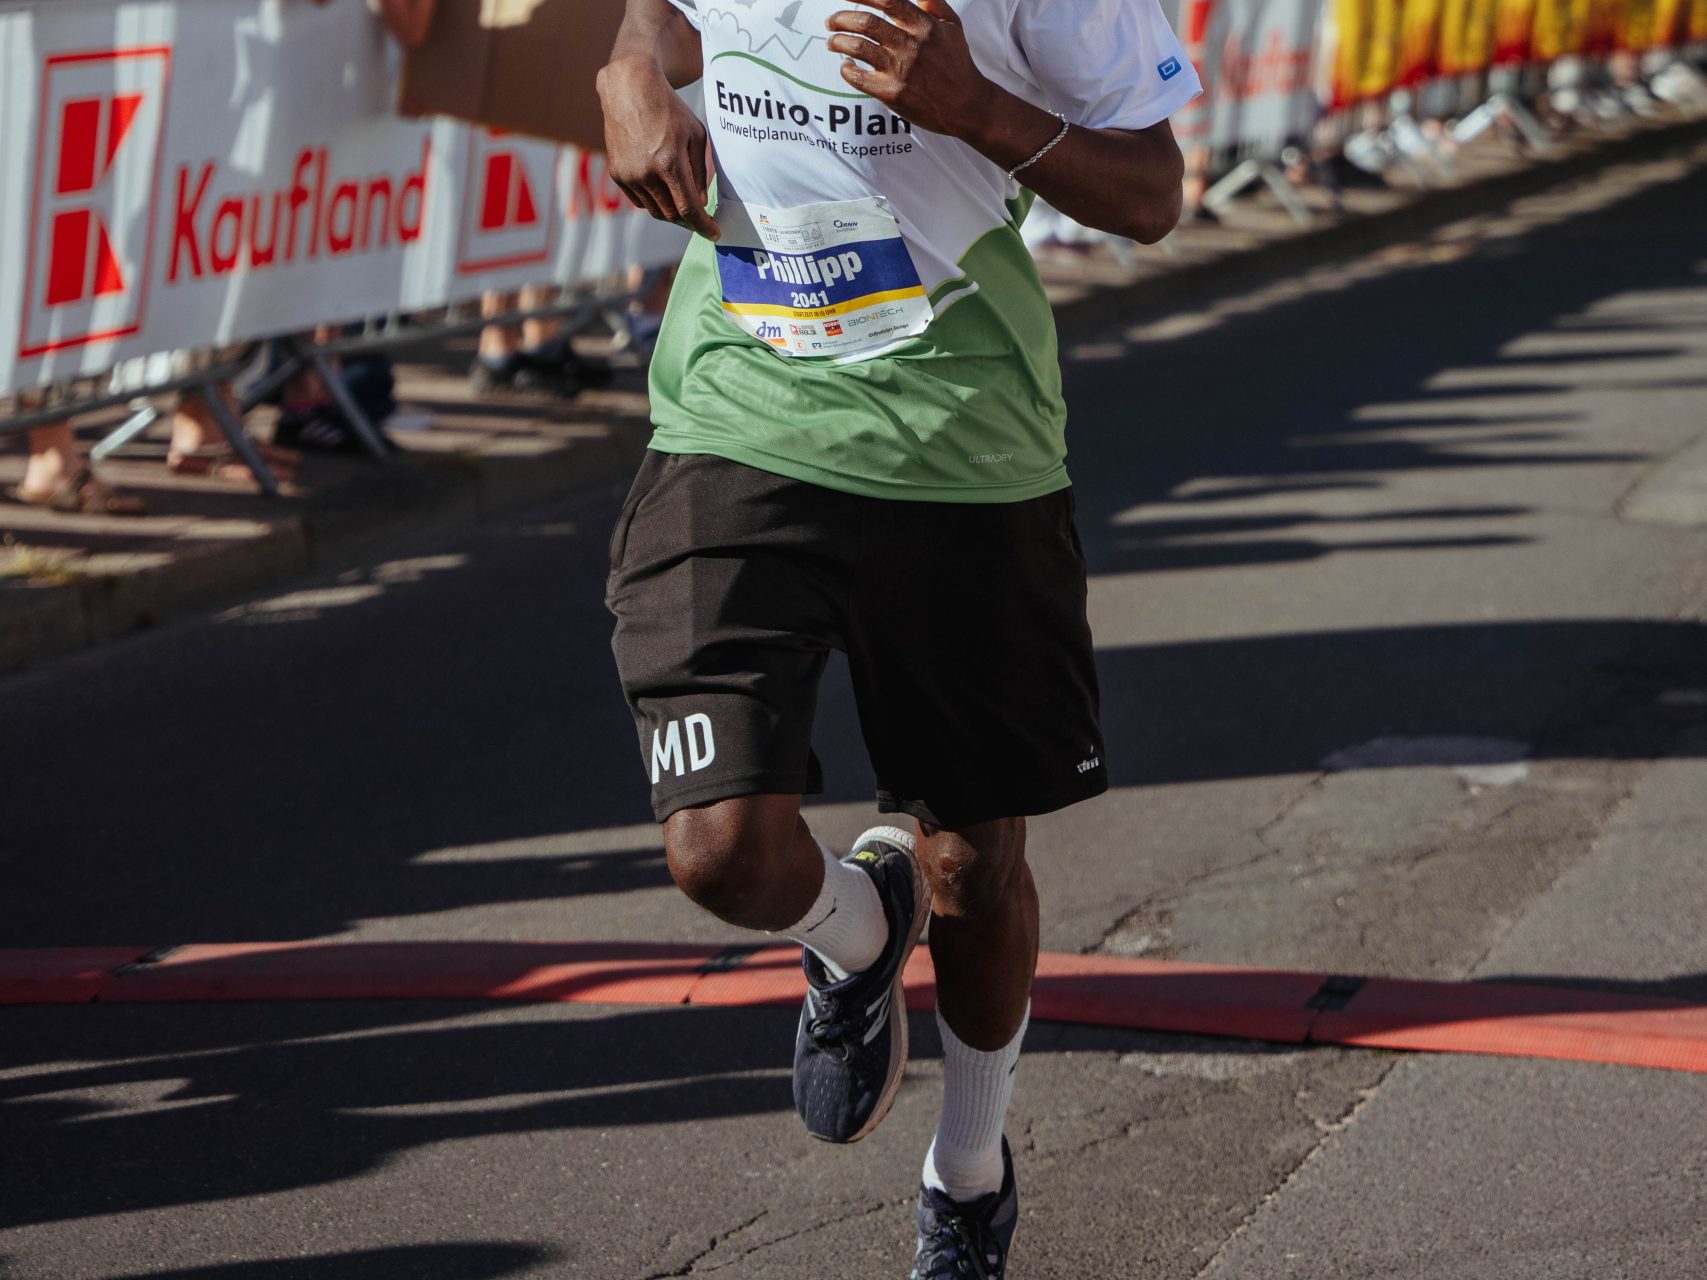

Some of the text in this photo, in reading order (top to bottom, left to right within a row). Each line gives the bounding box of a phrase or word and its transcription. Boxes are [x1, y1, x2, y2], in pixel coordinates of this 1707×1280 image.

[716, 80, 911, 135] Enviro-Plan
[719, 116, 912, 158] Umweltplanung mit Expertise
[167, 140, 432, 284] Kaufland
[753, 251, 863, 287] Phillipp
[790, 290, 830, 308] 2041
[848, 307, 904, 327] BIONTECH
[756, 321, 782, 338] dm
[651, 712, 715, 784] MD
